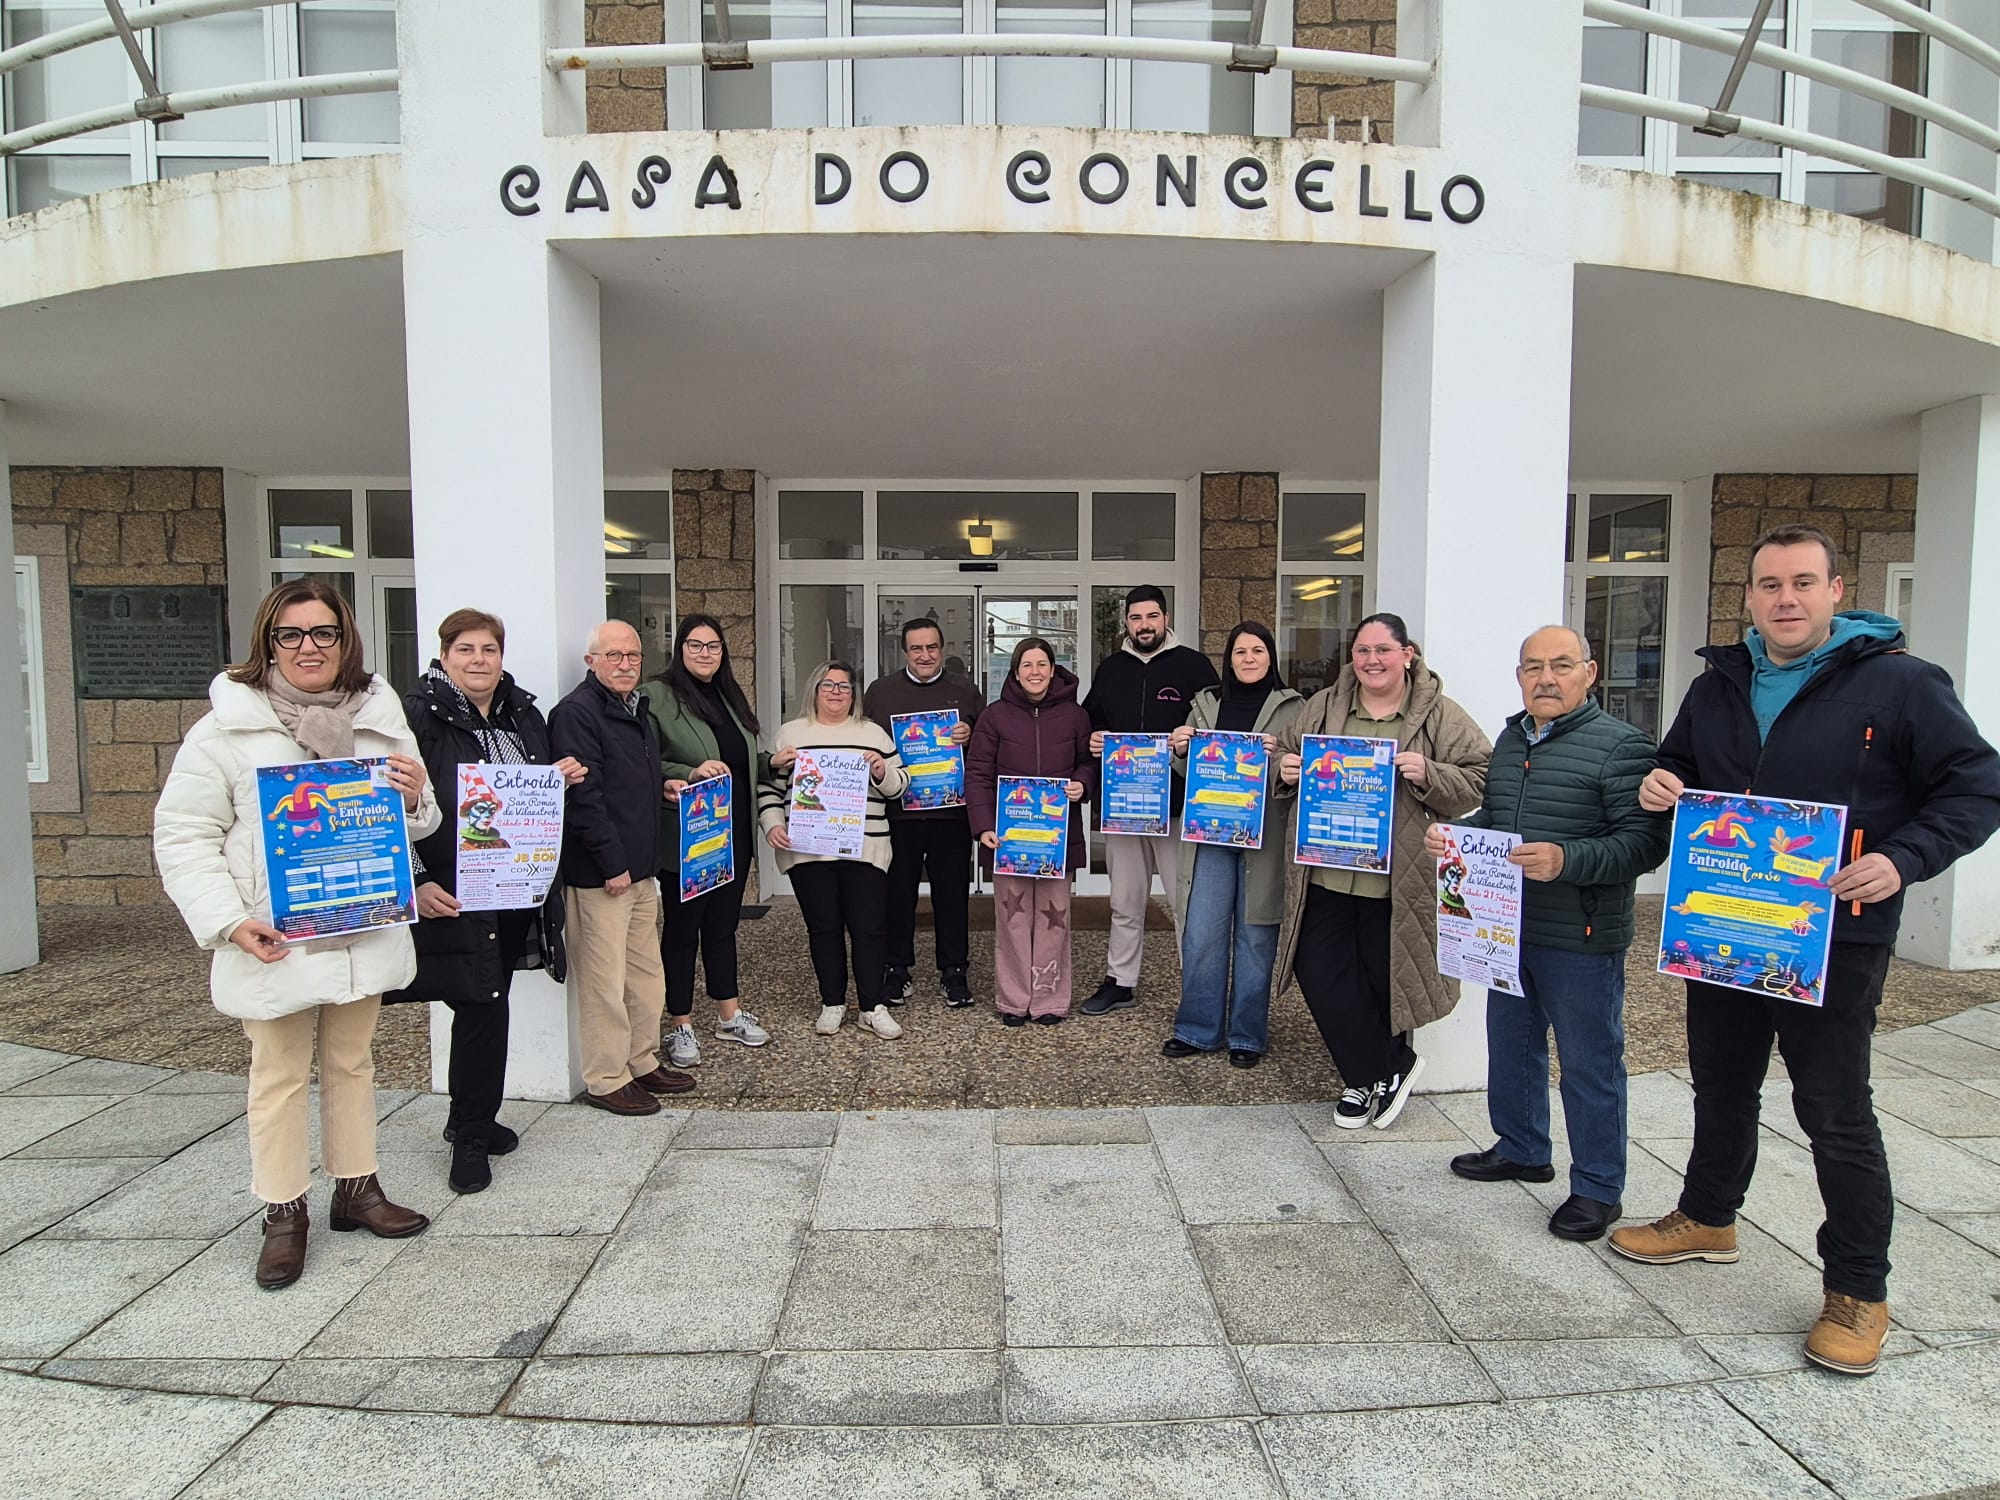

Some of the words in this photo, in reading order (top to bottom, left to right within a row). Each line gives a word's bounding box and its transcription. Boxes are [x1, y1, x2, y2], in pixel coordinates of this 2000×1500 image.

[499, 154, 742, 217] CASA
[814, 150, 930, 206] DO
[1005, 149, 1486, 225] CONCELLO
[819, 754, 867, 771] Entroido
[494, 770, 561, 789] Entroido
[1348, 774, 1383, 785] Entroido
[507, 797, 527, 807] San
[528, 797, 557, 807] Román
[339, 803, 389, 818] Entroido
[503, 807, 515, 816] de
[523, 818, 535, 826] 21
[1461, 834, 1513, 858] Entroid
[513, 853, 530, 863] JB
[533, 852, 557, 863] SON
[1688, 852, 1748, 871] Entroido
[1471, 864, 1487, 875] San
[1489, 867, 1516, 880] Román
[1483, 889, 1494, 900] 21
[1475, 927, 1489, 939] JB
[1491, 930, 1516, 947] SON
